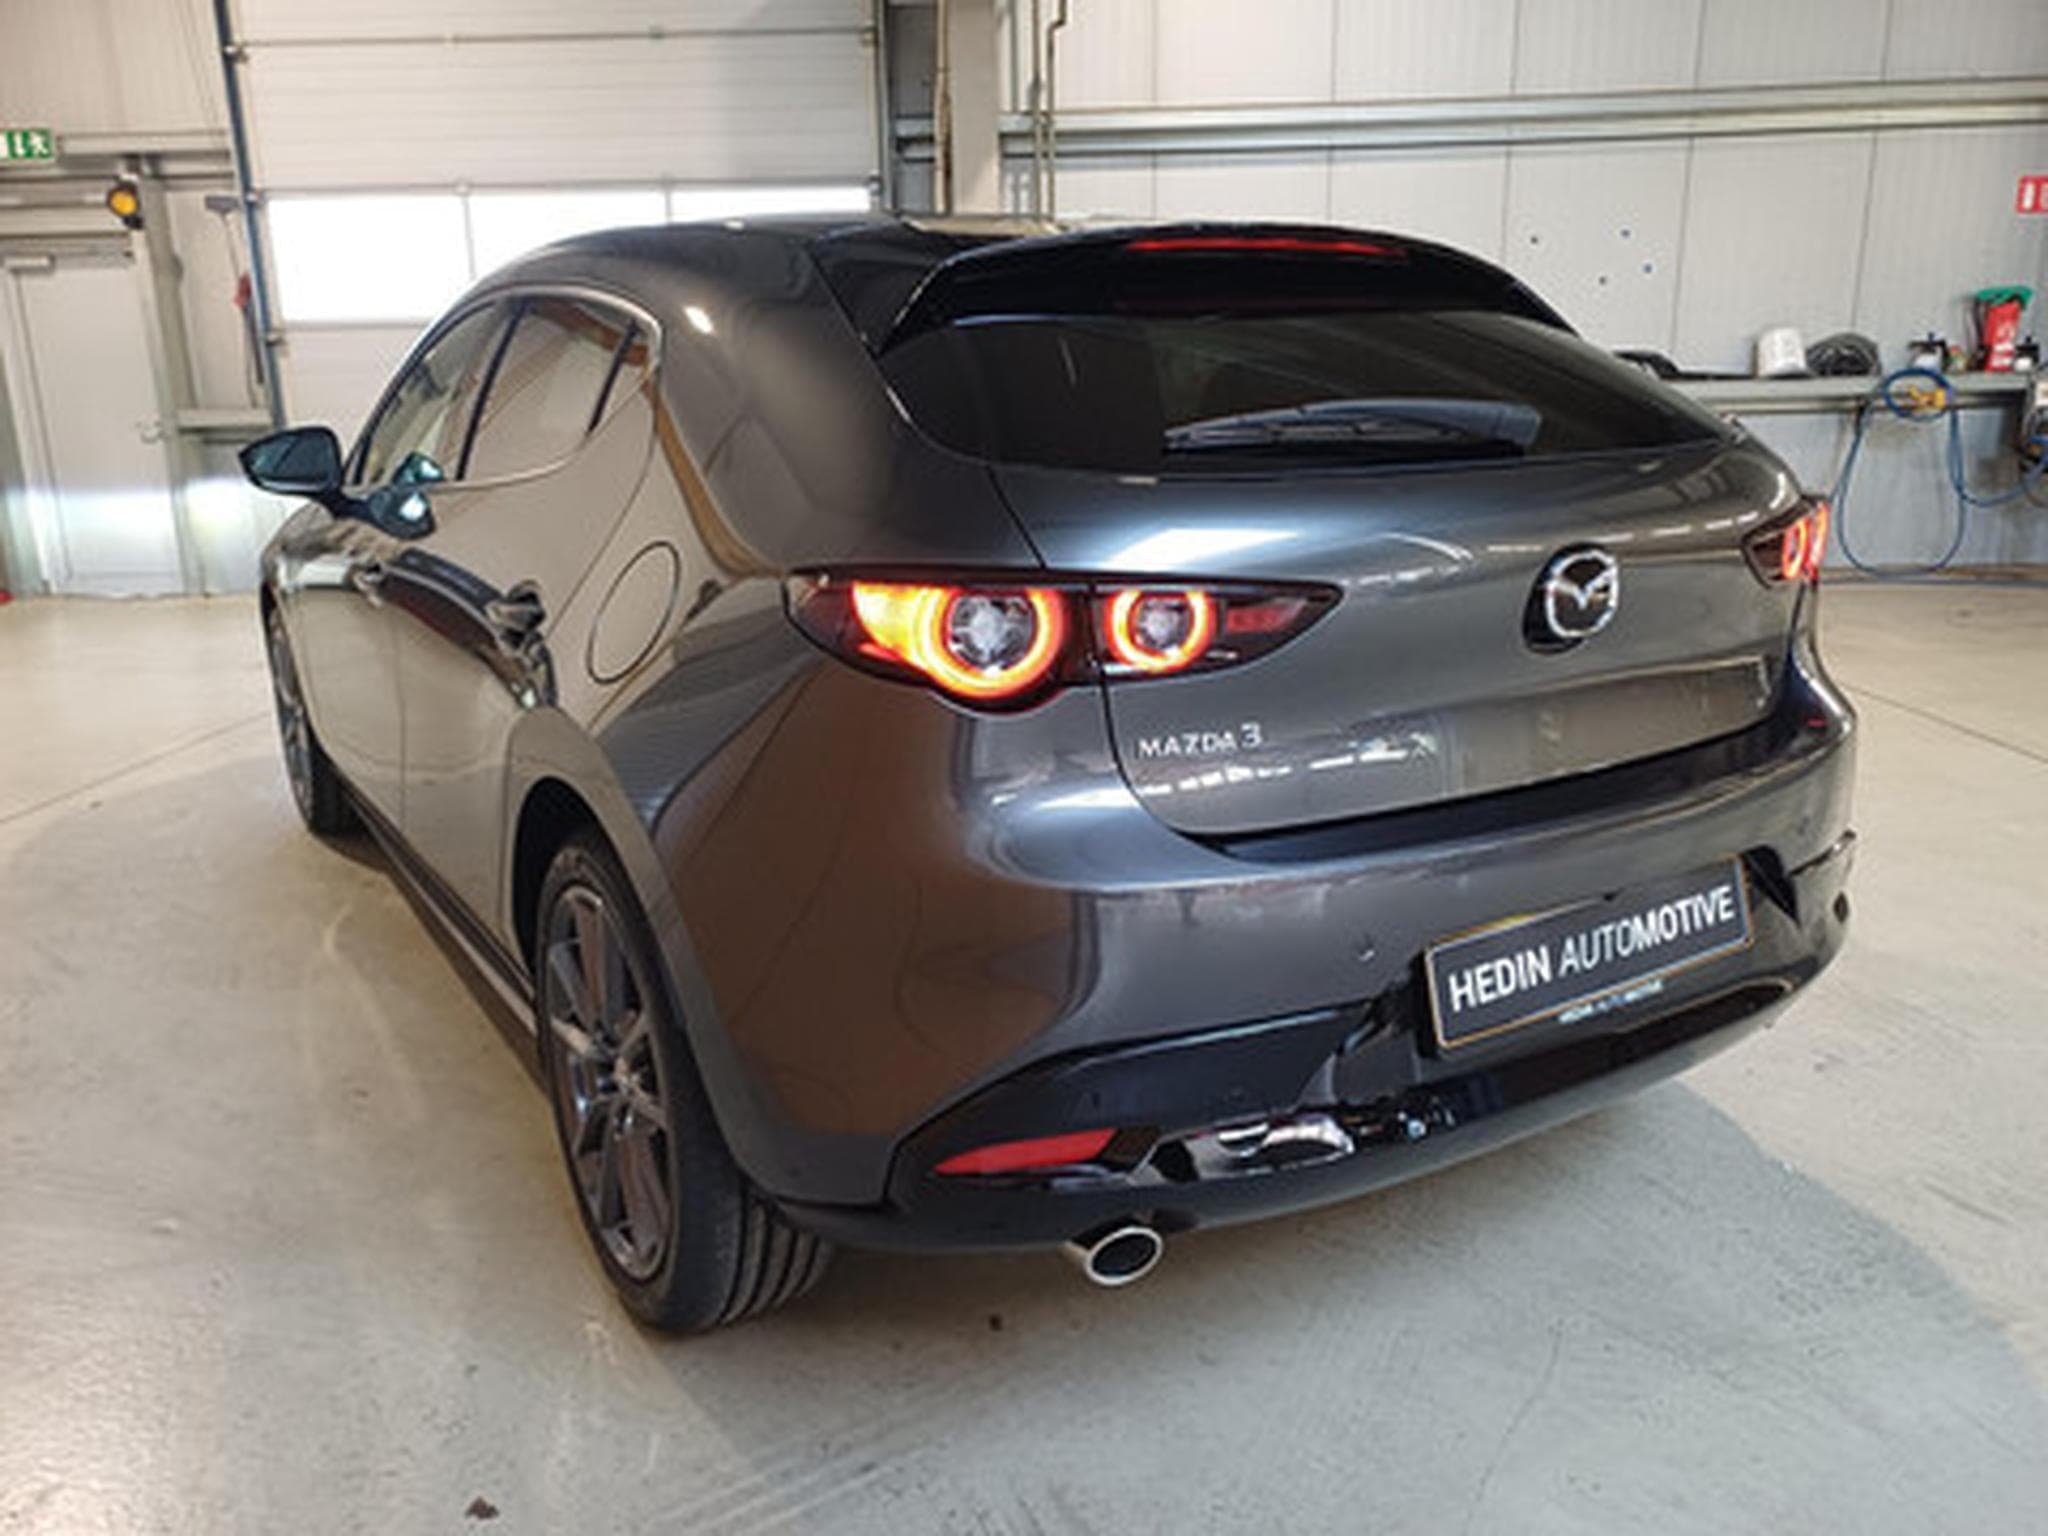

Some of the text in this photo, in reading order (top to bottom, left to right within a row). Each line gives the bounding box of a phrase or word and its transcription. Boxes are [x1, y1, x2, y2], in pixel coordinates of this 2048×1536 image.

[1138, 722, 1262, 757] MAZDA 3
[1449, 944, 1551, 1012] HEDIN
[1559, 885, 1735, 978] AUTOMOTIVE
